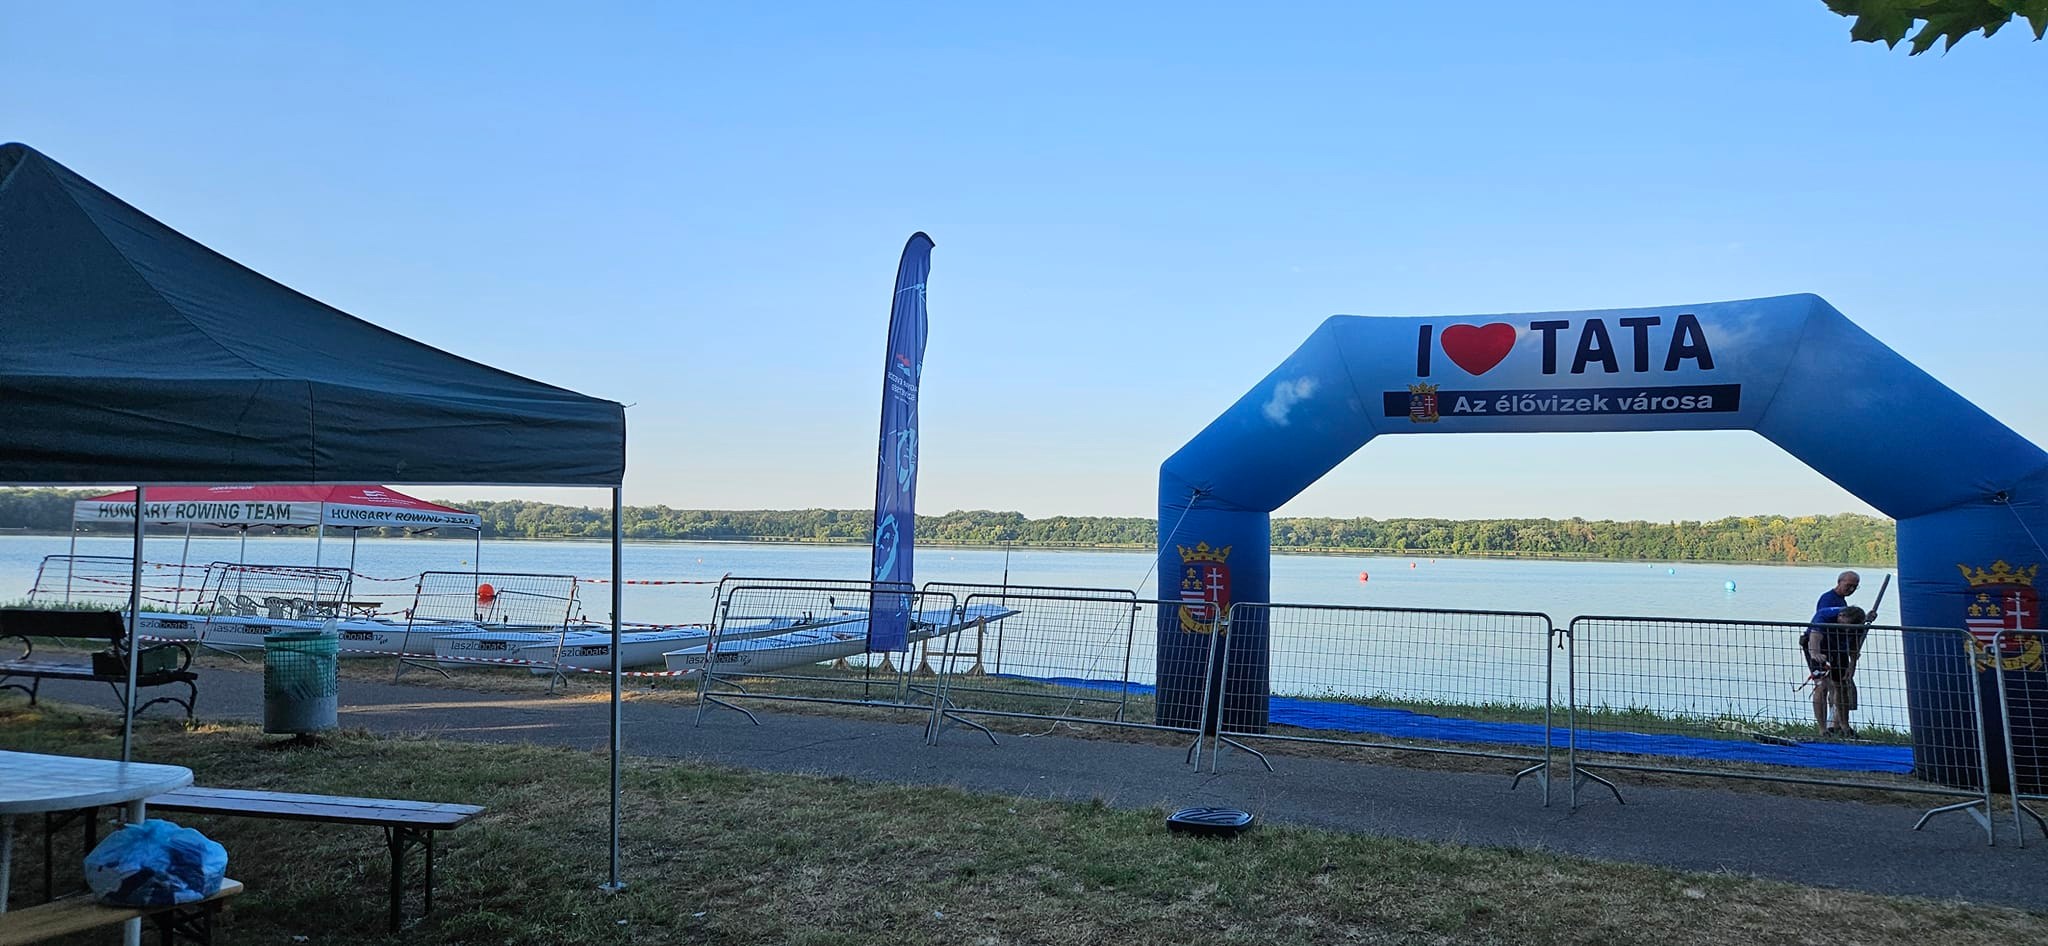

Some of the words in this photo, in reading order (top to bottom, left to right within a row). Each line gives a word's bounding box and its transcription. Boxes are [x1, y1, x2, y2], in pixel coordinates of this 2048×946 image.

[1417, 324, 1433, 377] I
[1529, 313, 1715, 375] TATA
[1453, 395, 1488, 413] Az
[1495, 393, 1609, 413] élővizek
[1617, 392, 1714, 411] városa
[175, 503, 240, 519] ROWING
[245, 503, 292, 520] TEAM
[331, 508, 392, 521] HUNGARY
